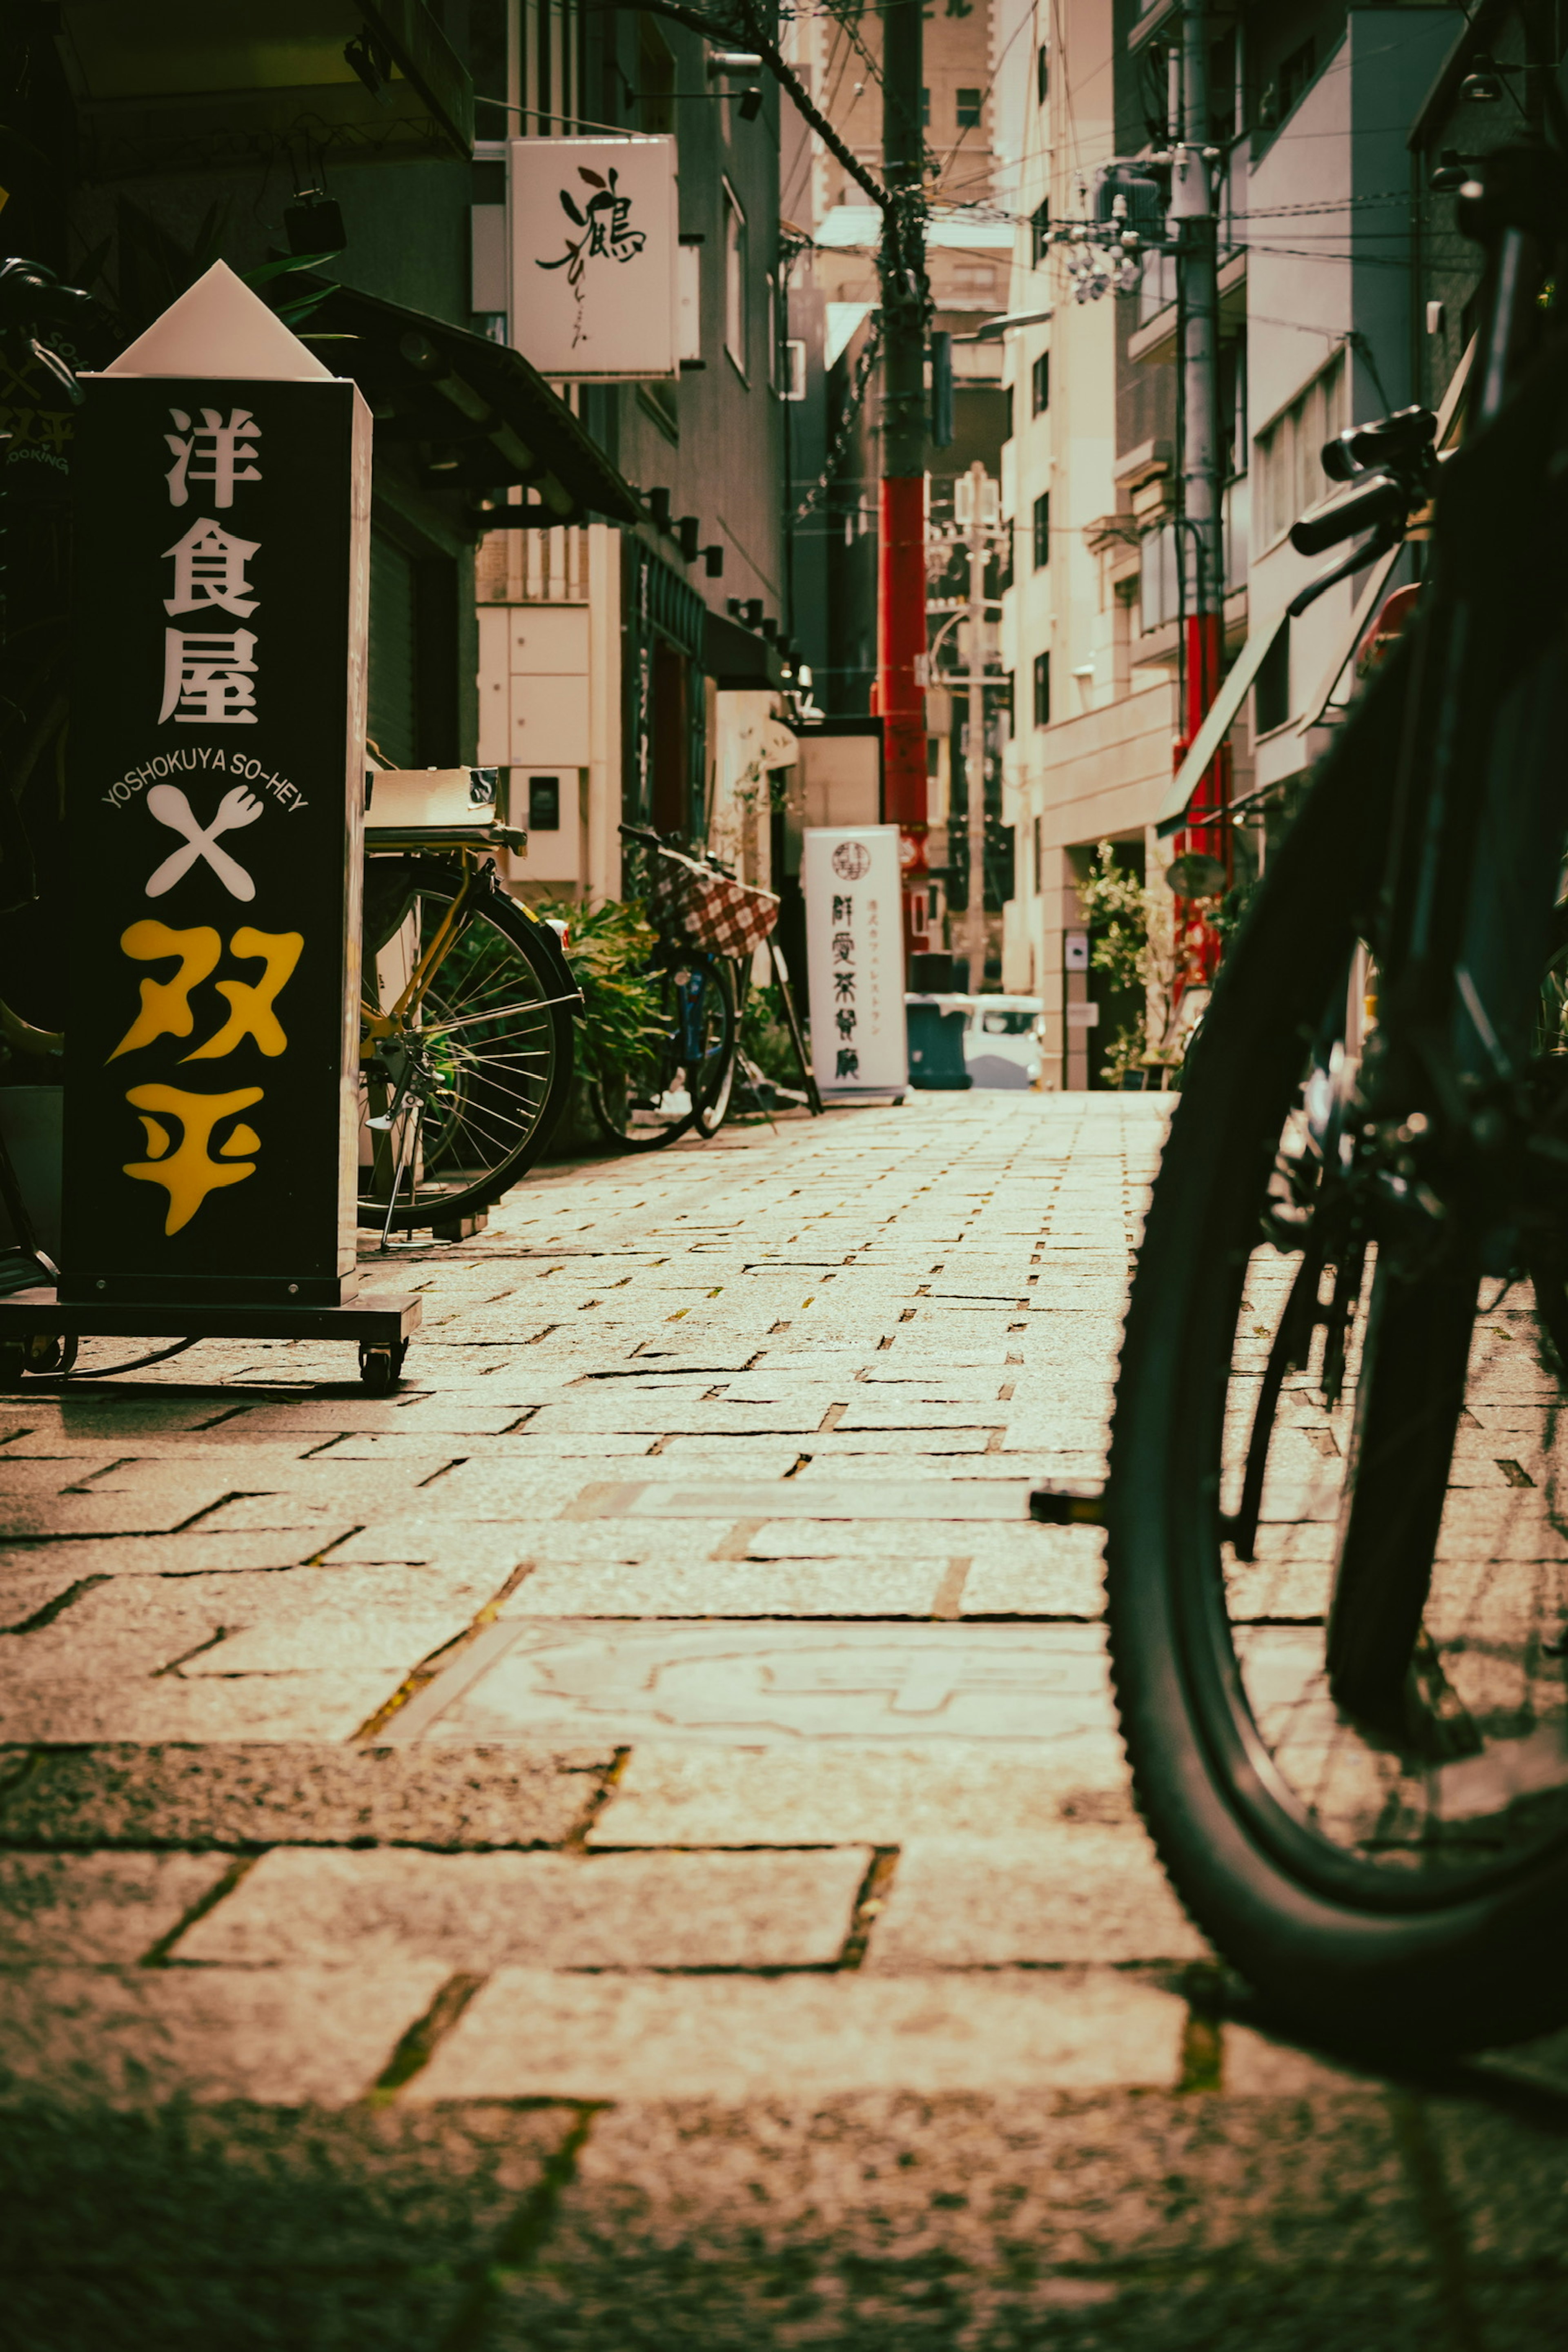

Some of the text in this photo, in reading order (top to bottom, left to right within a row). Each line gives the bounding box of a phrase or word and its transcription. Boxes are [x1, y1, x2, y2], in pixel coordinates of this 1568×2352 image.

[6, 439, 69, 475] OOKING
[158, 408, 263, 726] 洋食屋
[101, 748, 309, 813] YOSHOKUYA SO-HEY
[104, 919, 305, 1236] 双平
